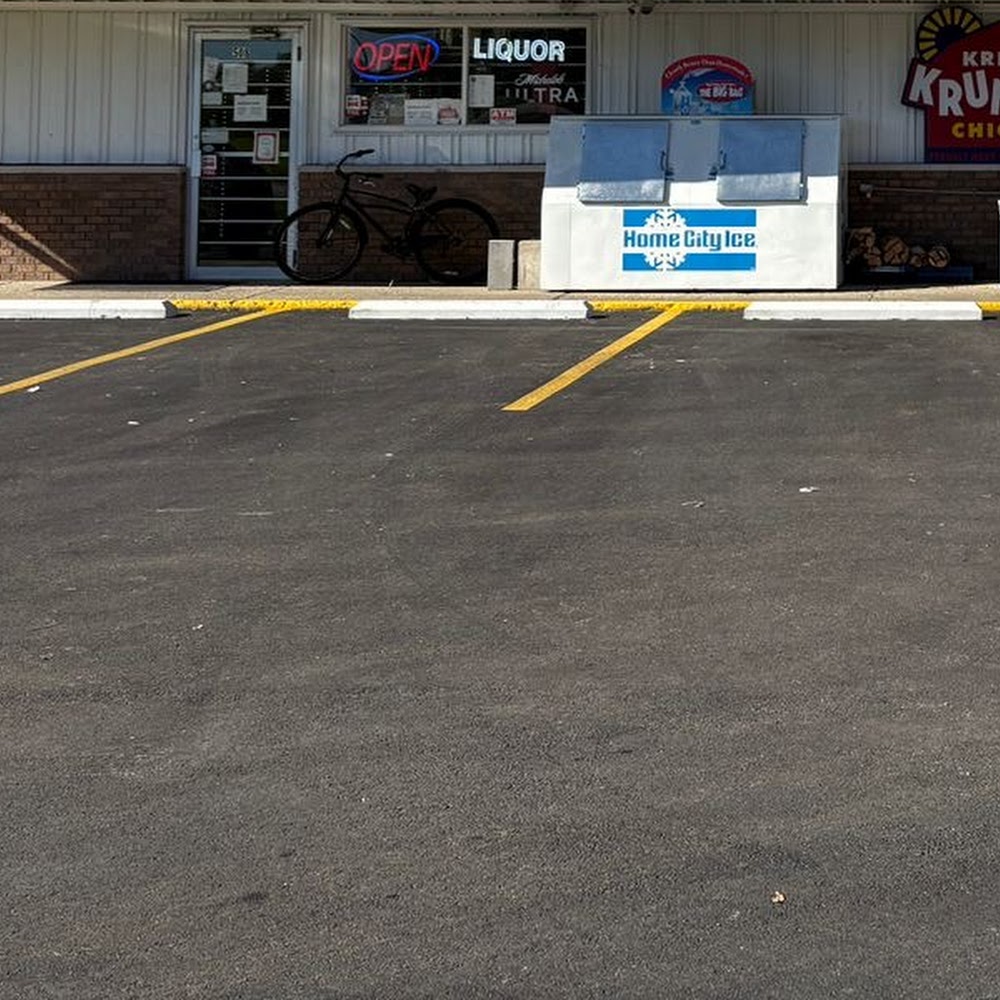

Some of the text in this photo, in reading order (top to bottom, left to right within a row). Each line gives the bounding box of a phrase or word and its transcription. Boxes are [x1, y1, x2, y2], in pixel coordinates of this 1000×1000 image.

[352, 41, 433, 73] OPEN
[472, 37, 566, 63] LIQUOR
[623, 230, 756, 251] Home City Ice
